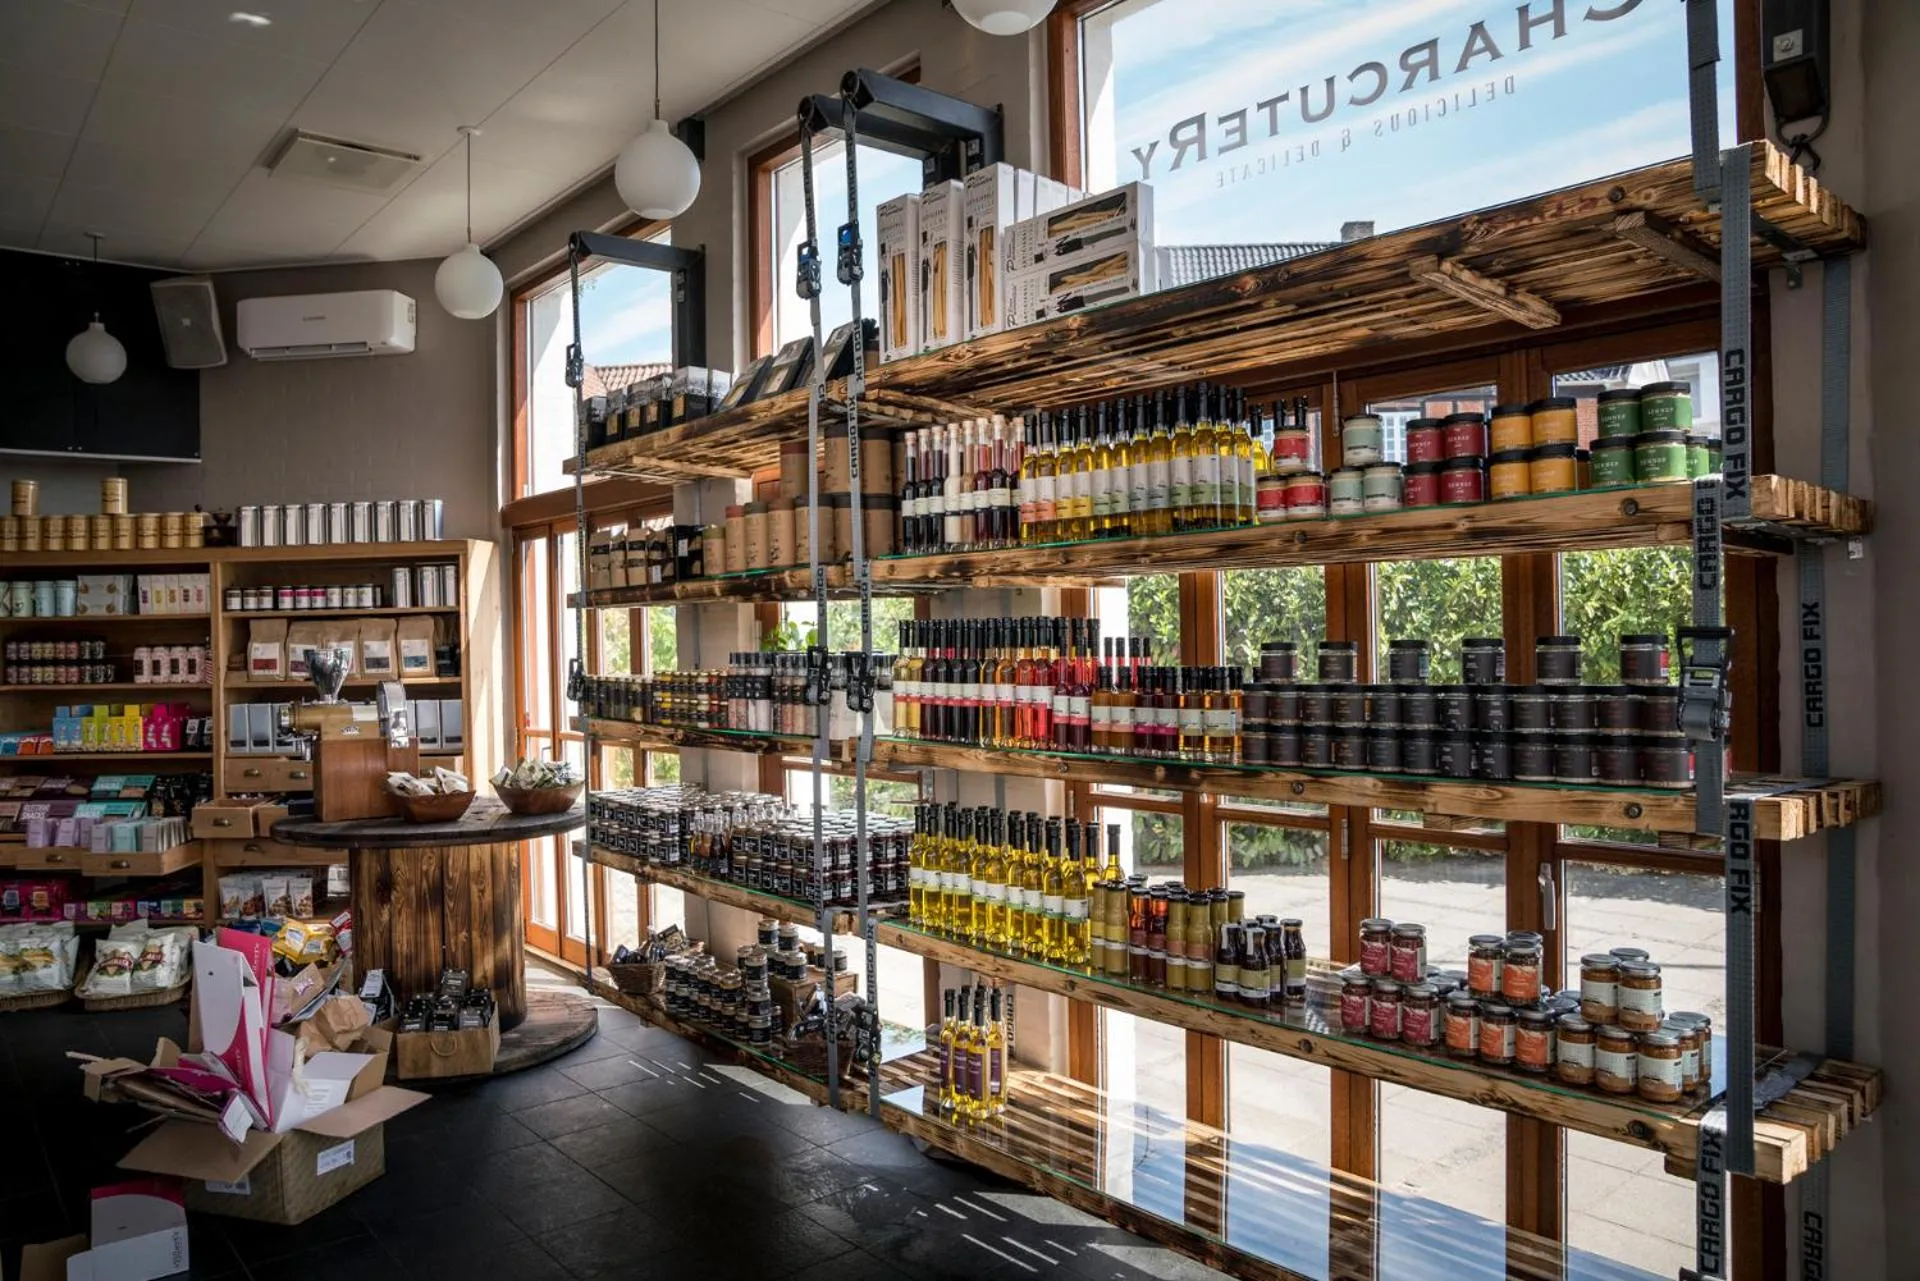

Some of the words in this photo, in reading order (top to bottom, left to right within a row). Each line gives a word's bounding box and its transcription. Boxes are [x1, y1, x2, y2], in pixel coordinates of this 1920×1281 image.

[854, 355, 864, 382] FIX
[1724, 348, 1746, 447] CARGO
[849, 426, 858, 479] CARGO
[1725, 452, 1747, 500] FIX
[1696, 496, 1717, 590] CARGO
[861, 582, 869, 634] CARGO
[1803, 601, 1820, 640] FIX
[1804, 646, 1824, 728] CARGO
[1730, 868, 1751, 914] FIX
[866, 923, 875, 948] FIX
[866, 952, 875, 1005] CARGO
[1006, 994, 1015, 1041] CARGO
[1700, 1126, 1721, 1175] FIX
[1700, 1180, 1721, 1275] CARGO
[1804, 1210, 1824, 1281] CARG
